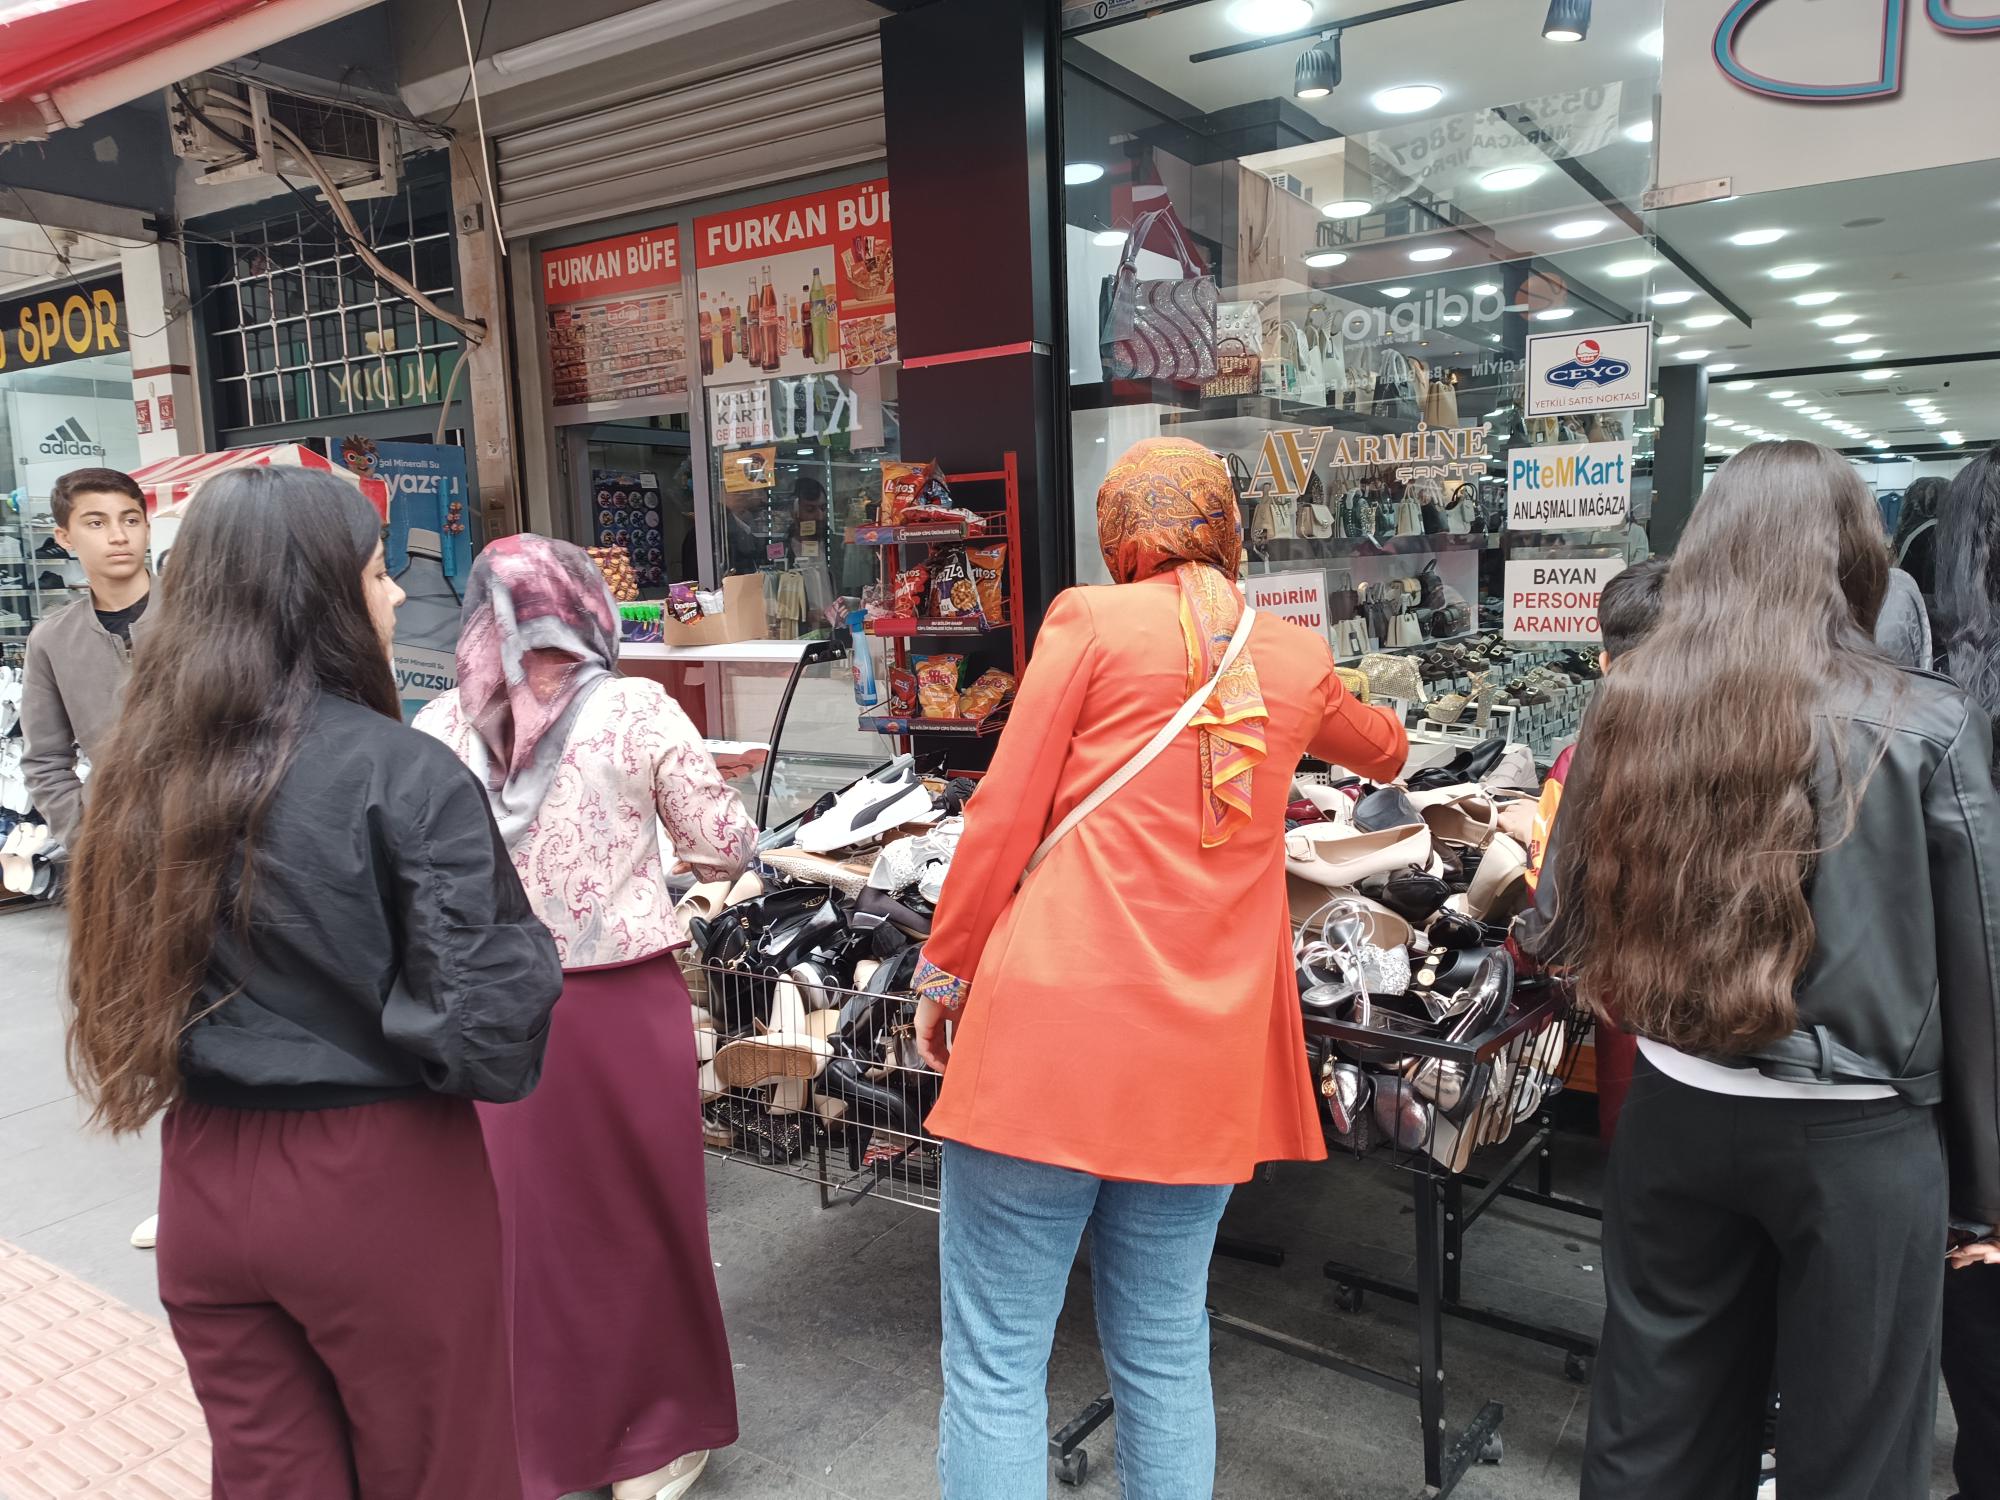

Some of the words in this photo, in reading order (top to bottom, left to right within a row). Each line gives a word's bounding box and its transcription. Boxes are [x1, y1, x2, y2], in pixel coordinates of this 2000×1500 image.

[707, 204, 827, 256] FURKAN
[547, 249, 621, 289] FURKAN
[626, 236, 677, 275] BÜFE
[18, 289, 120, 363] SPOR
[1549, 365, 1626, 381] CEYO
[1597, 392, 1640, 403] NOKTASI
[39, 439, 104, 457] adidas
[1329, 421, 1488, 467] ARMİNE
[1396, 462, 1487, 484] ÇANTA
[1513, 498, 1576, 523] ANLAŞMALI
[1579, 492, 1626, 517] MAĞAZA
[1533, 568, 1597, 585] BAYAN
[1256, 586, 1317, 607] İNDİRİM
[1513, 592, 1601, 609] PERSONE
[1513, 616, 1600, 633] ARANIYO
[395, 668, 454, 691] eyazsu
